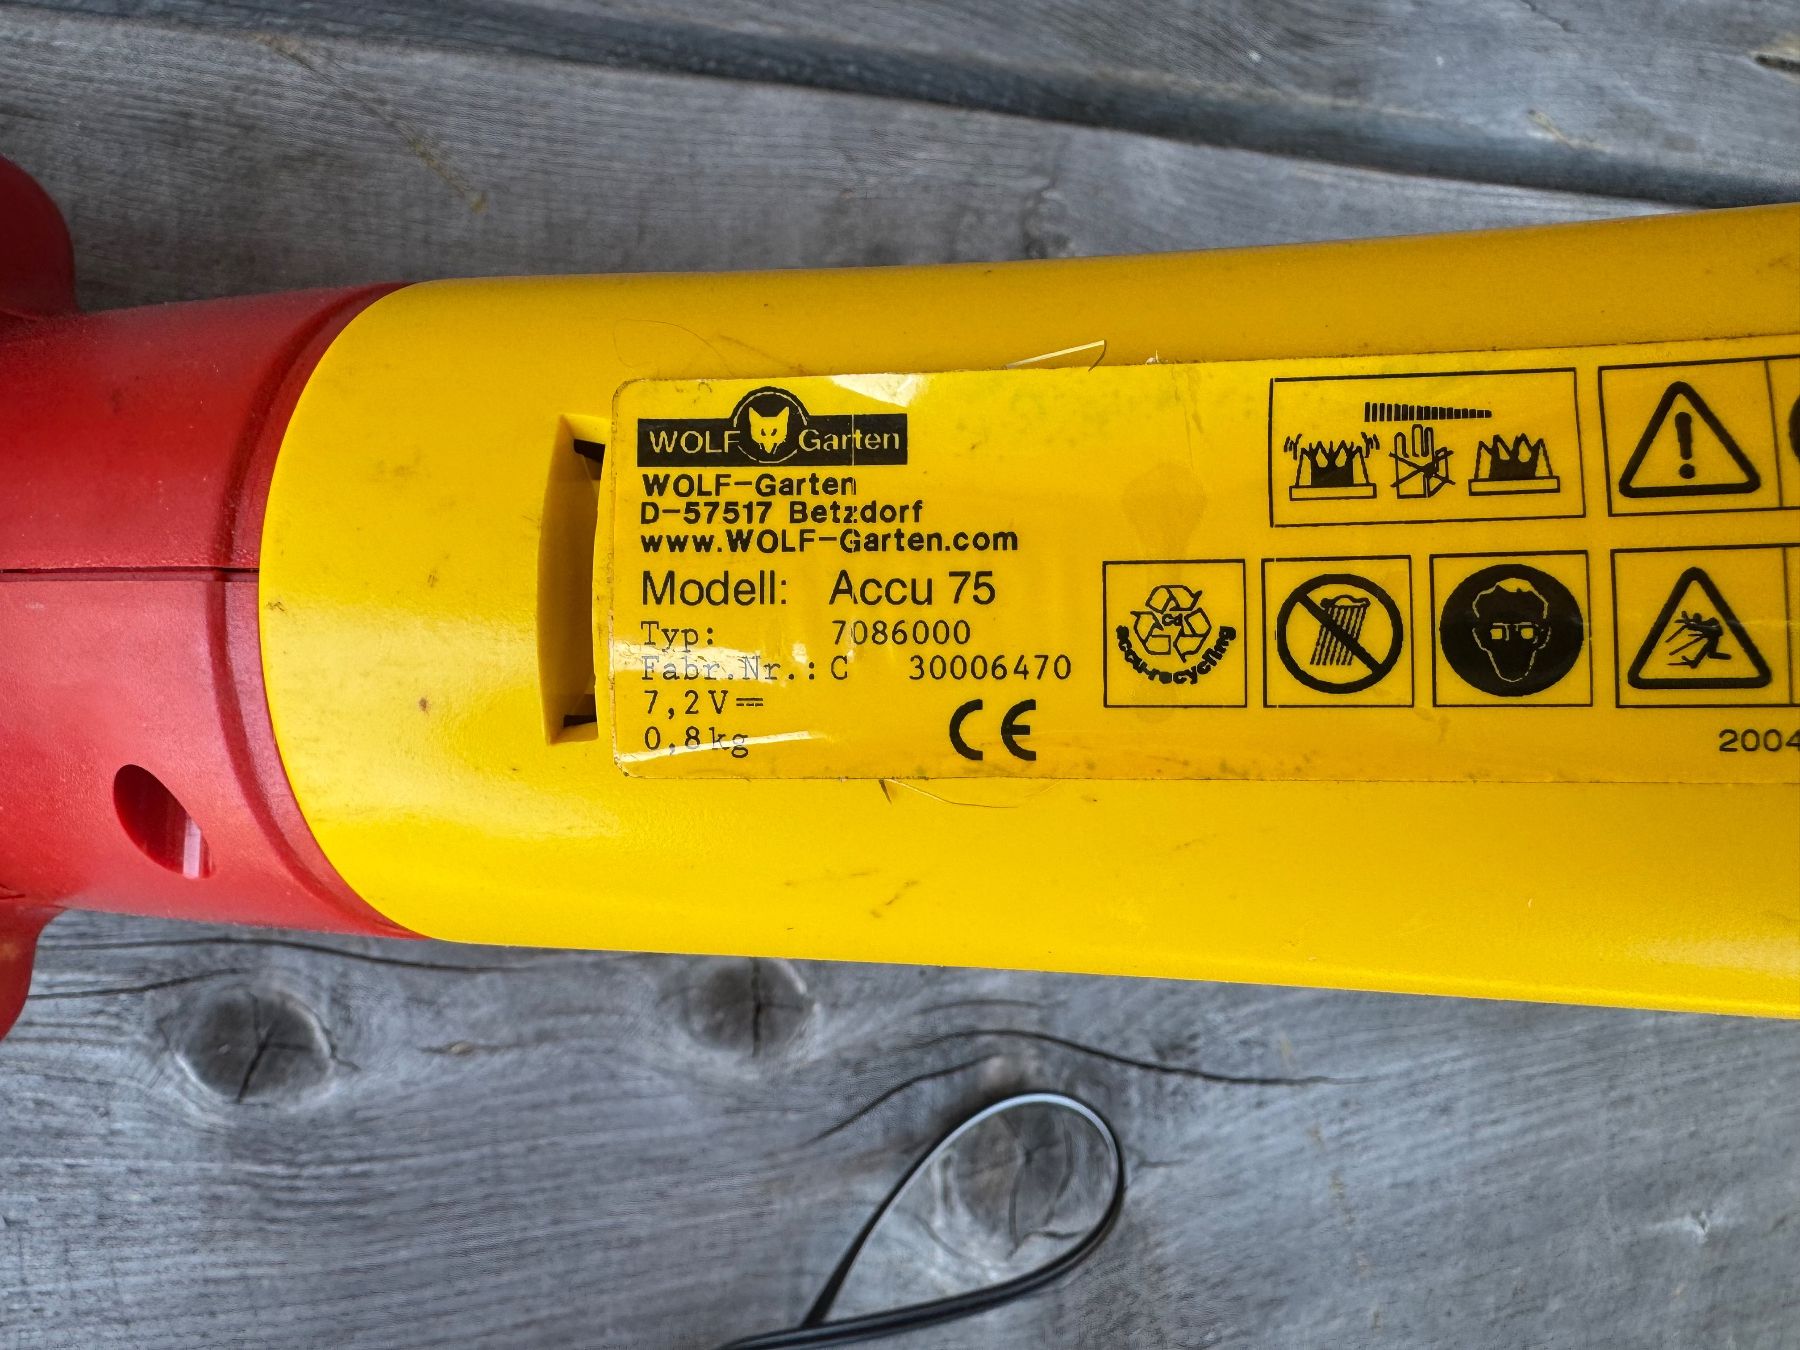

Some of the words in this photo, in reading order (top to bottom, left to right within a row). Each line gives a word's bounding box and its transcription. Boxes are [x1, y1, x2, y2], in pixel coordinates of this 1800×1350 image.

[650, 430, 741, 454] WOLF
[798, 429, 901, 452] Garten
[642, 474, 857, 497] WOLF-Garten
[640, 501, 773, 525] D-57517
[788, 500, 925, 524] Betzdorf
[641, 528, 1019, 554] www.WOLF-Garten.com
[641, 571, 788, 606] Modell:
[828, 570, 933, 606] Accu
[948, 571, 997, 605] 75
[641, 621, 715, 652] Typ:
[832, 620, 972, 645] 7086000
[830, 655, 849, 681] C
[909, 654, 1073, 681] 30006470
[1719, 728, 1800, 753] 2004
